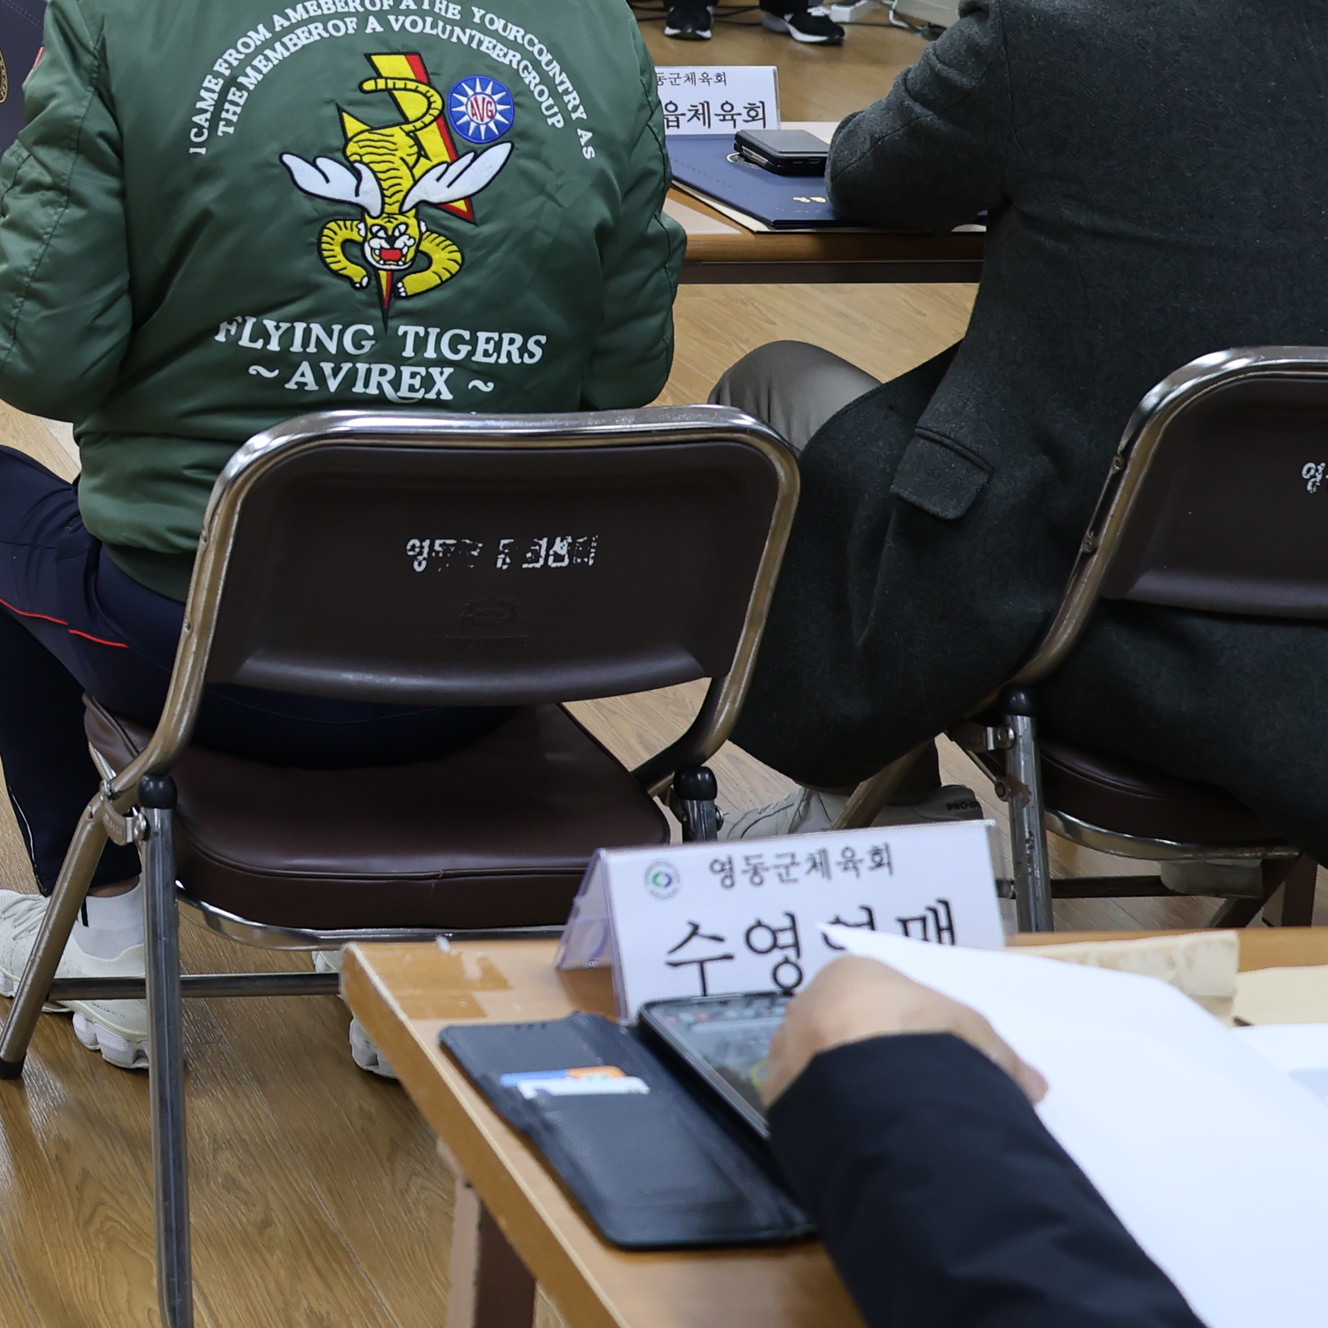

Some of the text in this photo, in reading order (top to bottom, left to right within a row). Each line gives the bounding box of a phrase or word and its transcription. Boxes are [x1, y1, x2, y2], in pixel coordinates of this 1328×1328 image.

[364, 15, 384, 34] A
[190, 75, 224, 143] CAME
[213, 23, 272, 77] FROM
[577, 128, 595, 160] AS
[470, 95, 494, 122] AVG
[214, 315, 547, 364] FLYING TIGERS
[284, 361, 454, 404] AVIREX
[708, 841, 894, 890] 영동군체육회
